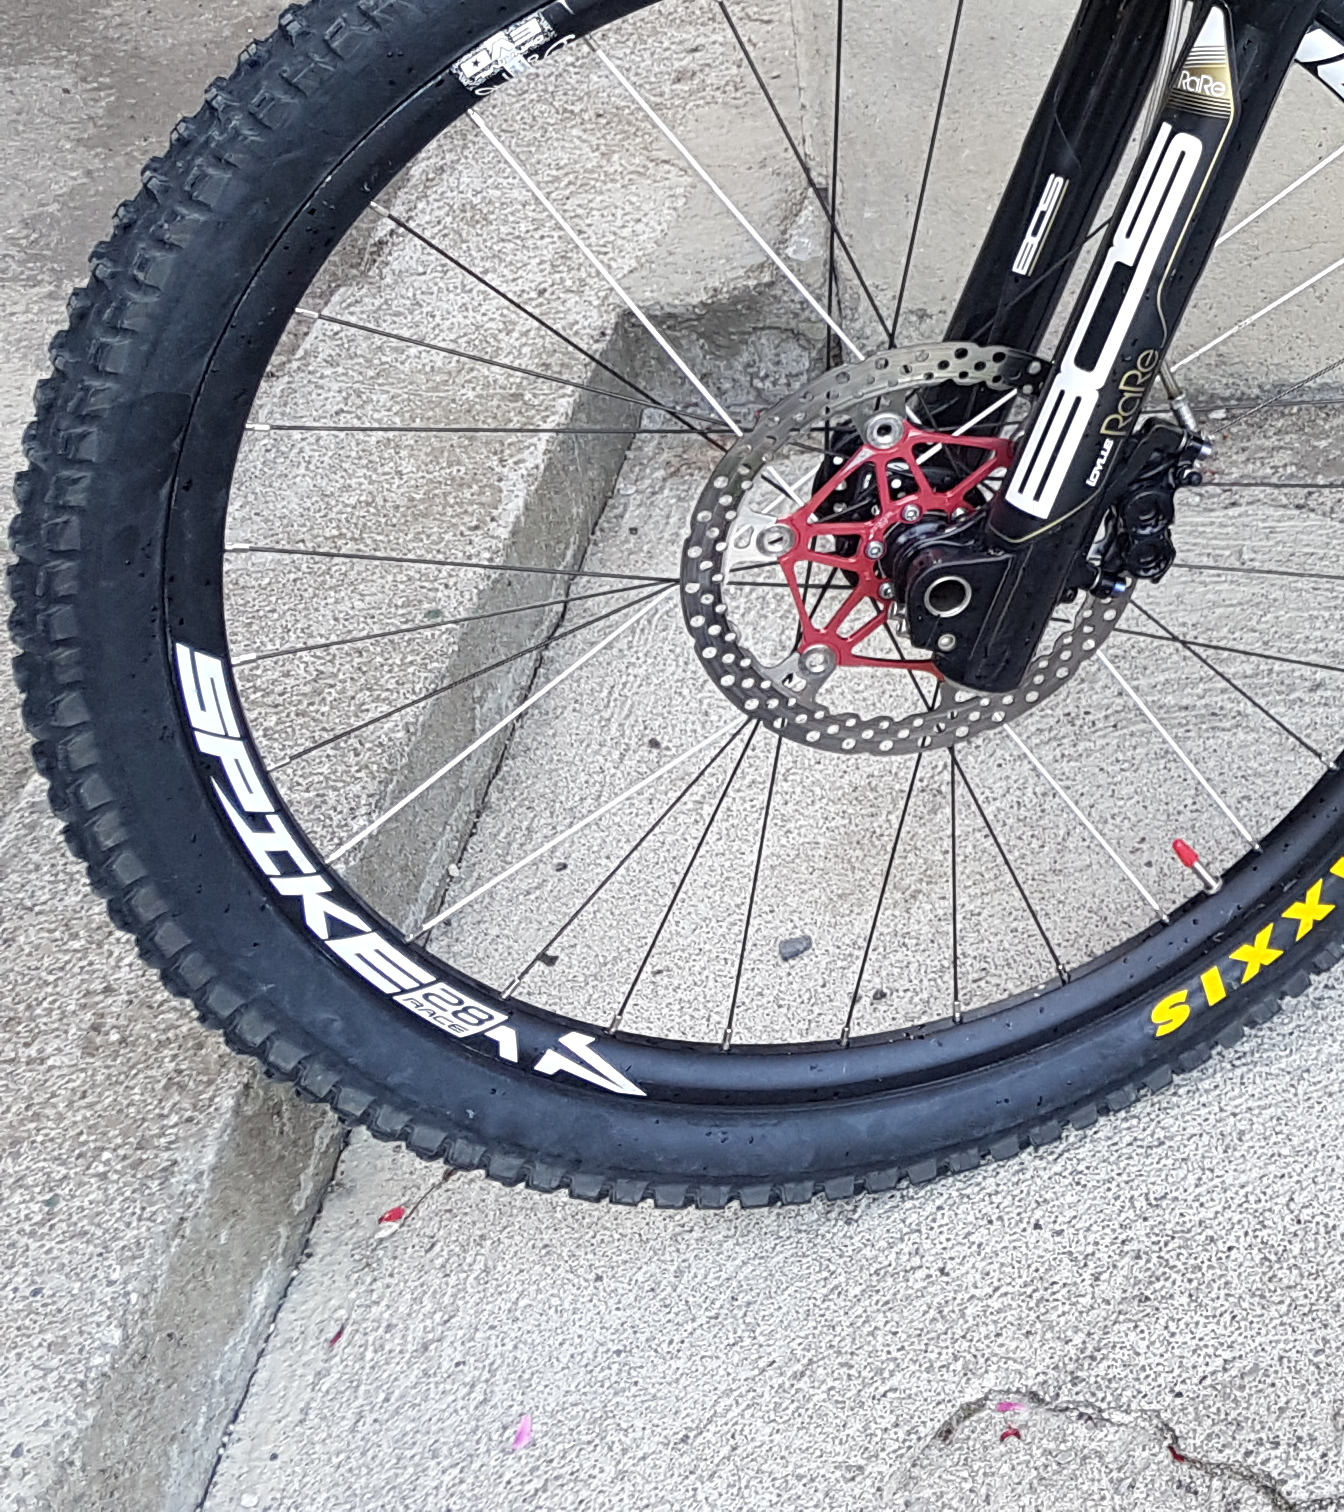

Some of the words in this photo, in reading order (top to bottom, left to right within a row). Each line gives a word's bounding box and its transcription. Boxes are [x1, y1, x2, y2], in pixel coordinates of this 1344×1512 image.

[175, 643, 436, 994] SPIKE
[420, 986, 496, 1028] 28
[407, 997, 466, 1036] RACE
